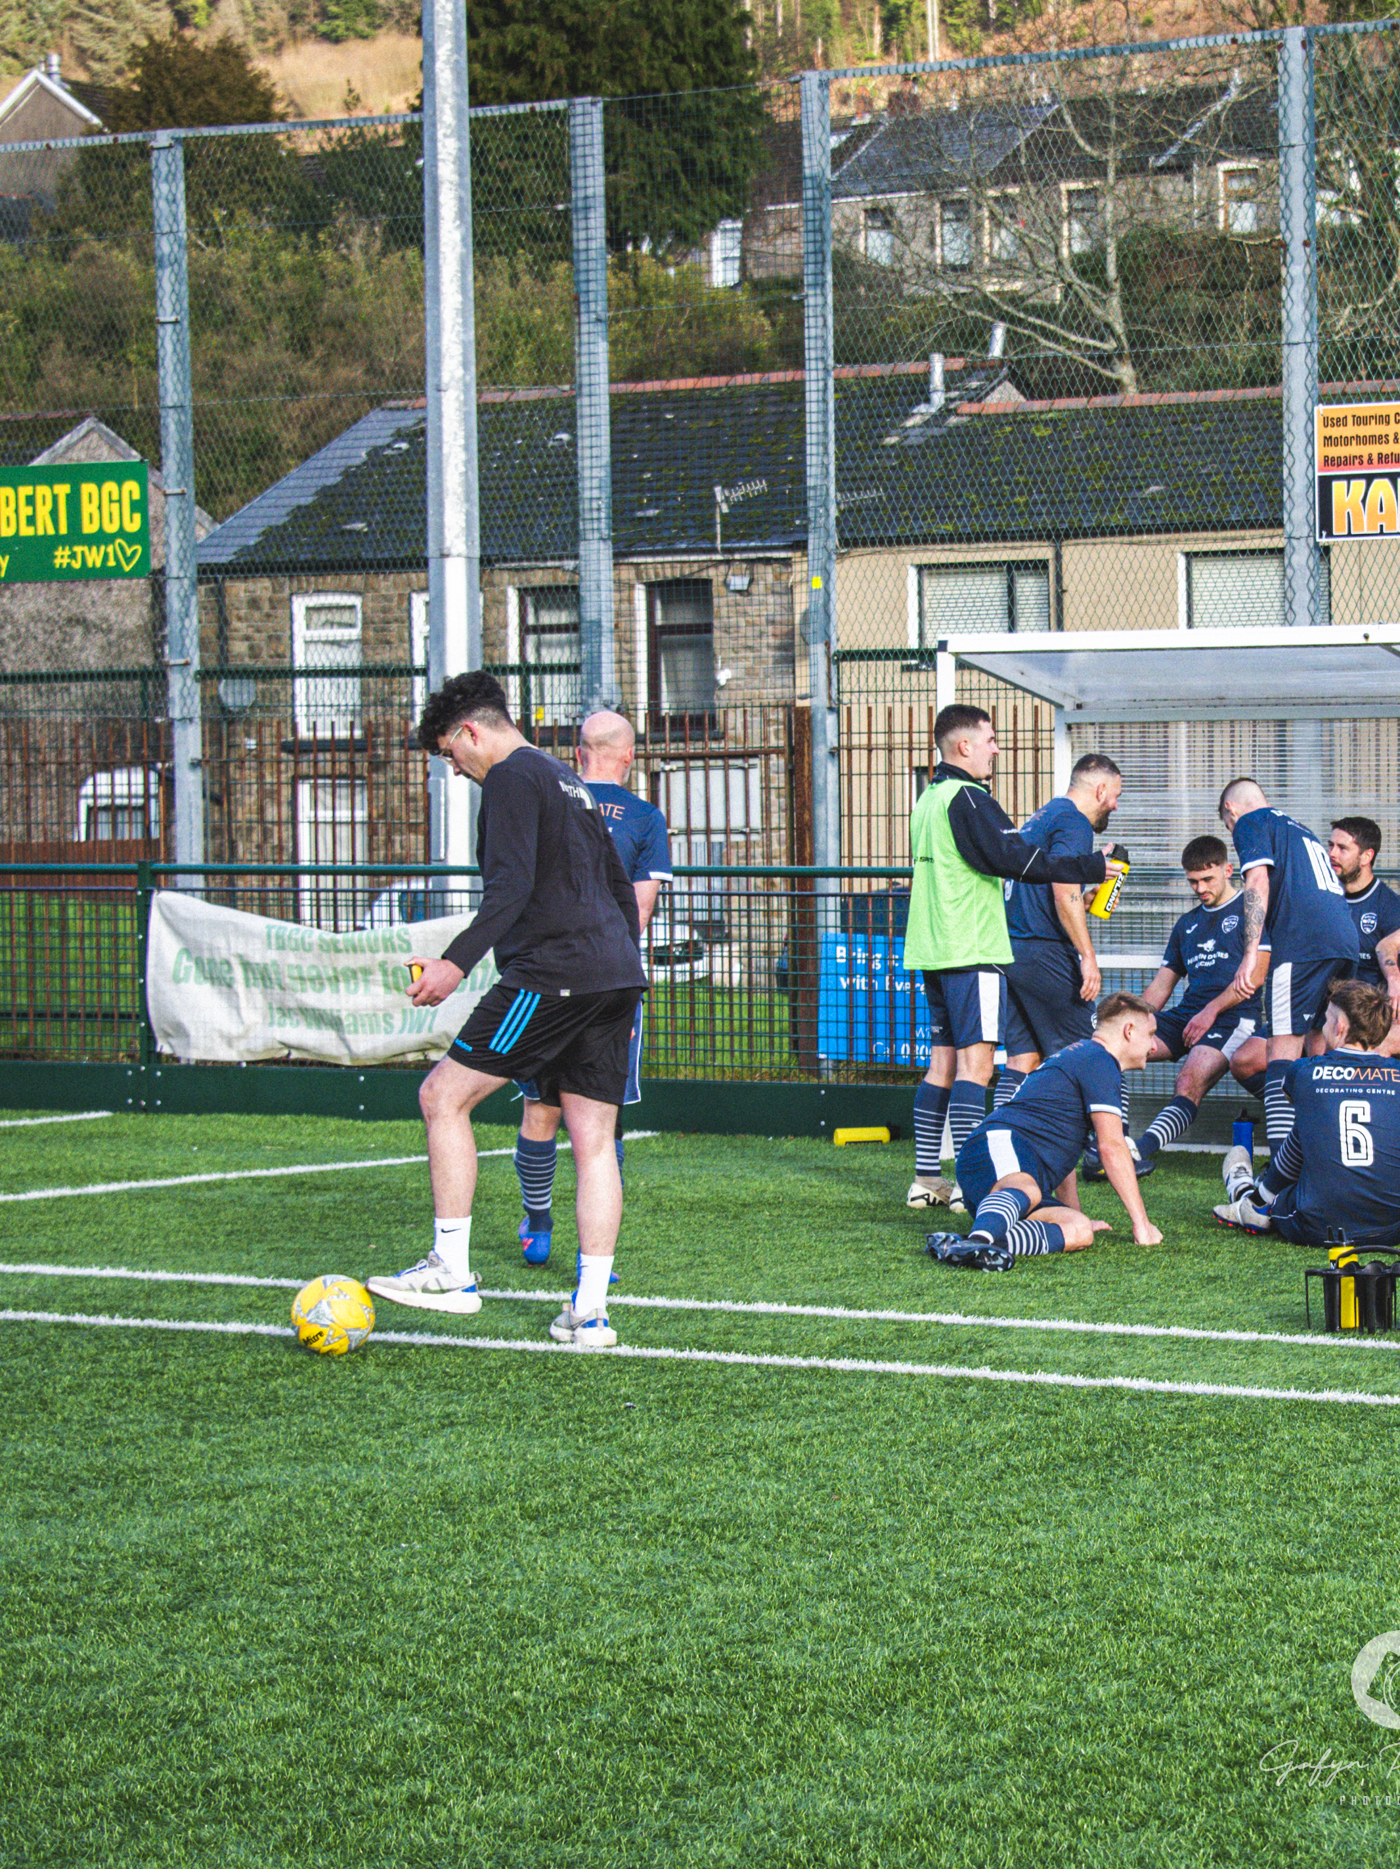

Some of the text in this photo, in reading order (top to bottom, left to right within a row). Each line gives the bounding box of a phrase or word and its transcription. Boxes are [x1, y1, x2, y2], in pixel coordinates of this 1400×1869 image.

[1322, 415, 1348, 429] Used
[1350, 412, 1391, 428] Touring
[1323, 432, 1392, 448] Motorhomes
[1393, 432, 1400, 444] &
[1323, 453, 1365, 468] Repairs
[1367, 453, 1374, 465] &
[80, 480, 142, 534] BGC
[53, 544, 117, 569] #JW1
[1301, 836, 1345, 896] 10
[317, 927, 413, 954] SENIORS
[286, 960, 372, 995] never
[1365, 1088, 1396, 1096] CENTRE
[1339, 1100, 1374, 1167] 6
